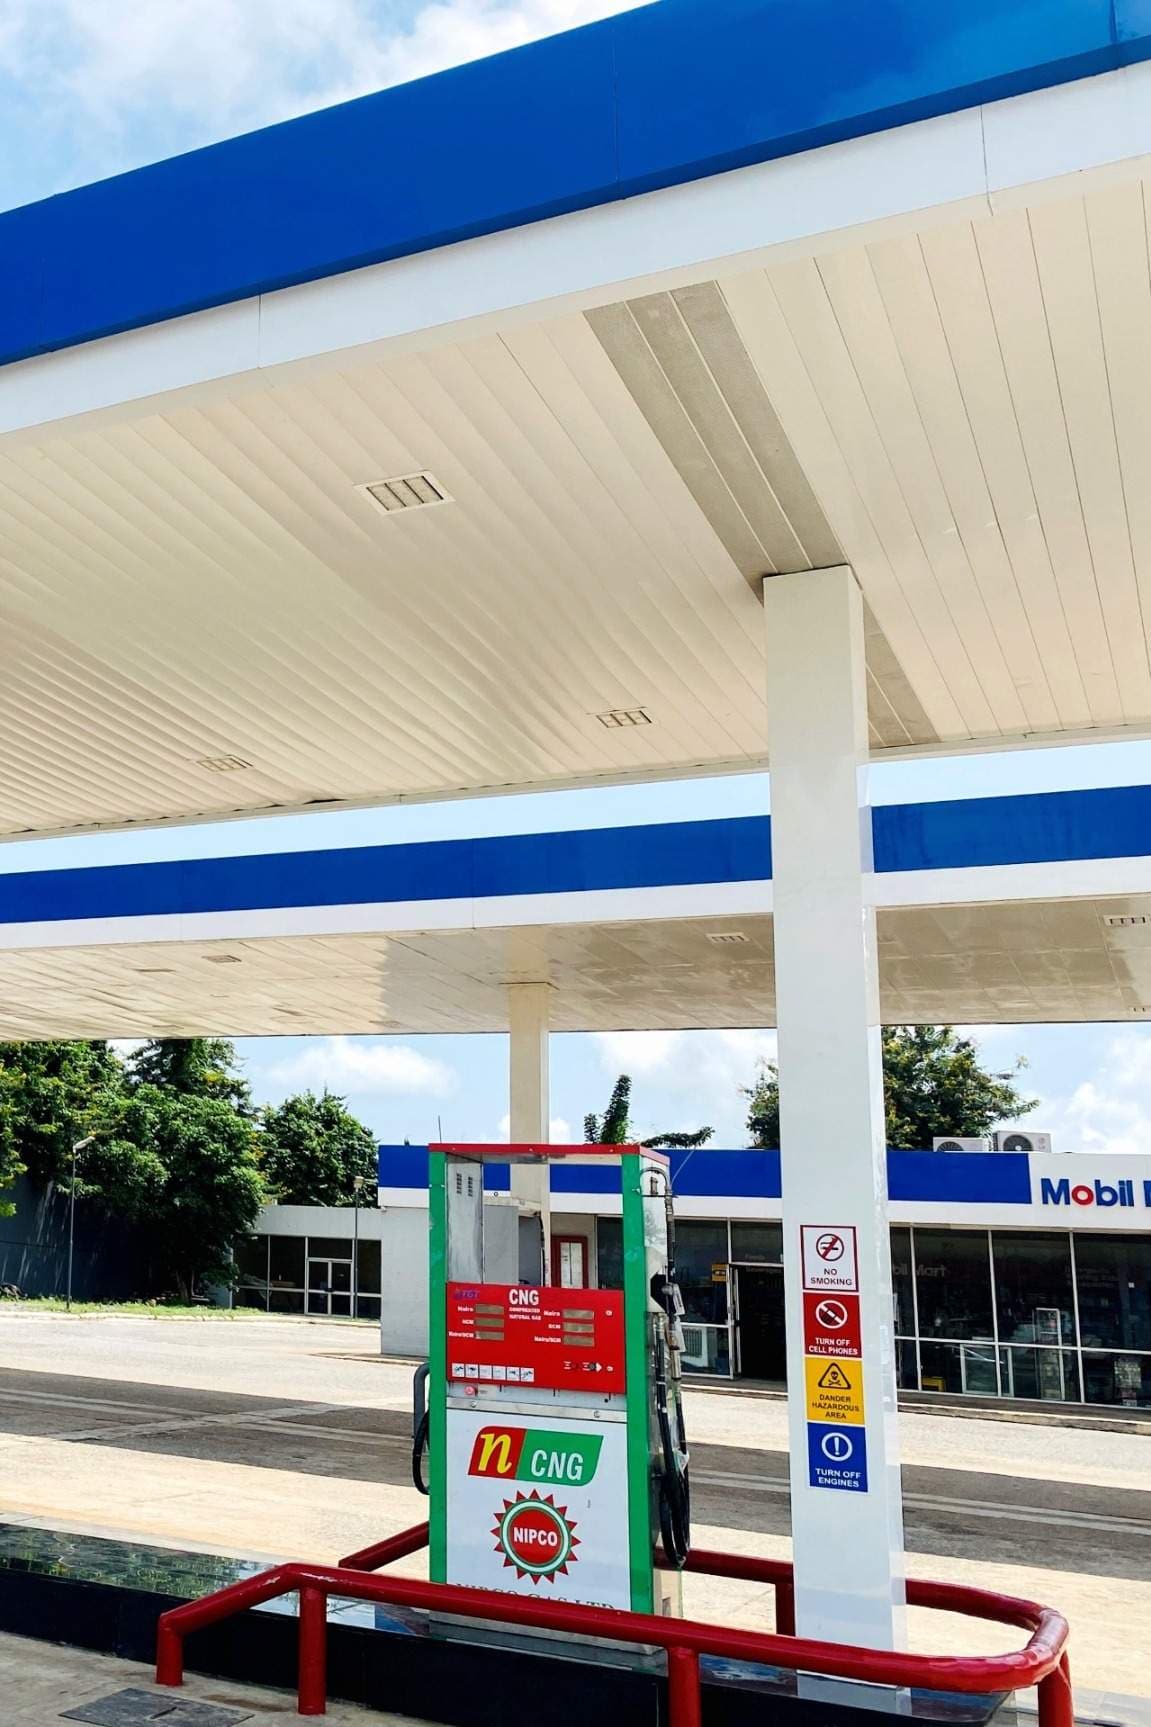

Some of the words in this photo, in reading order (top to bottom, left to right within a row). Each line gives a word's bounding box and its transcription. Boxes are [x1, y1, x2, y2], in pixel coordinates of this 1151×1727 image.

[1041, 1178, 1135, 1207] Mobil
[810, 1277, 852, 1286] SMOKING
[509, 1289, 539, 1306] CNG
[809, 1345, 826, 1353] CELL
[828, 1346, 858, 1356] PHONES
[812, 1402, 859, 1412] HAZARDOUS
[531, 1450, 584, 1481] CNG
[816, 1468, 840, 1476] TURN
[818, 1476, 860, 1487] ENGINES
[513, 1526, 558, 1546] NIPCO
